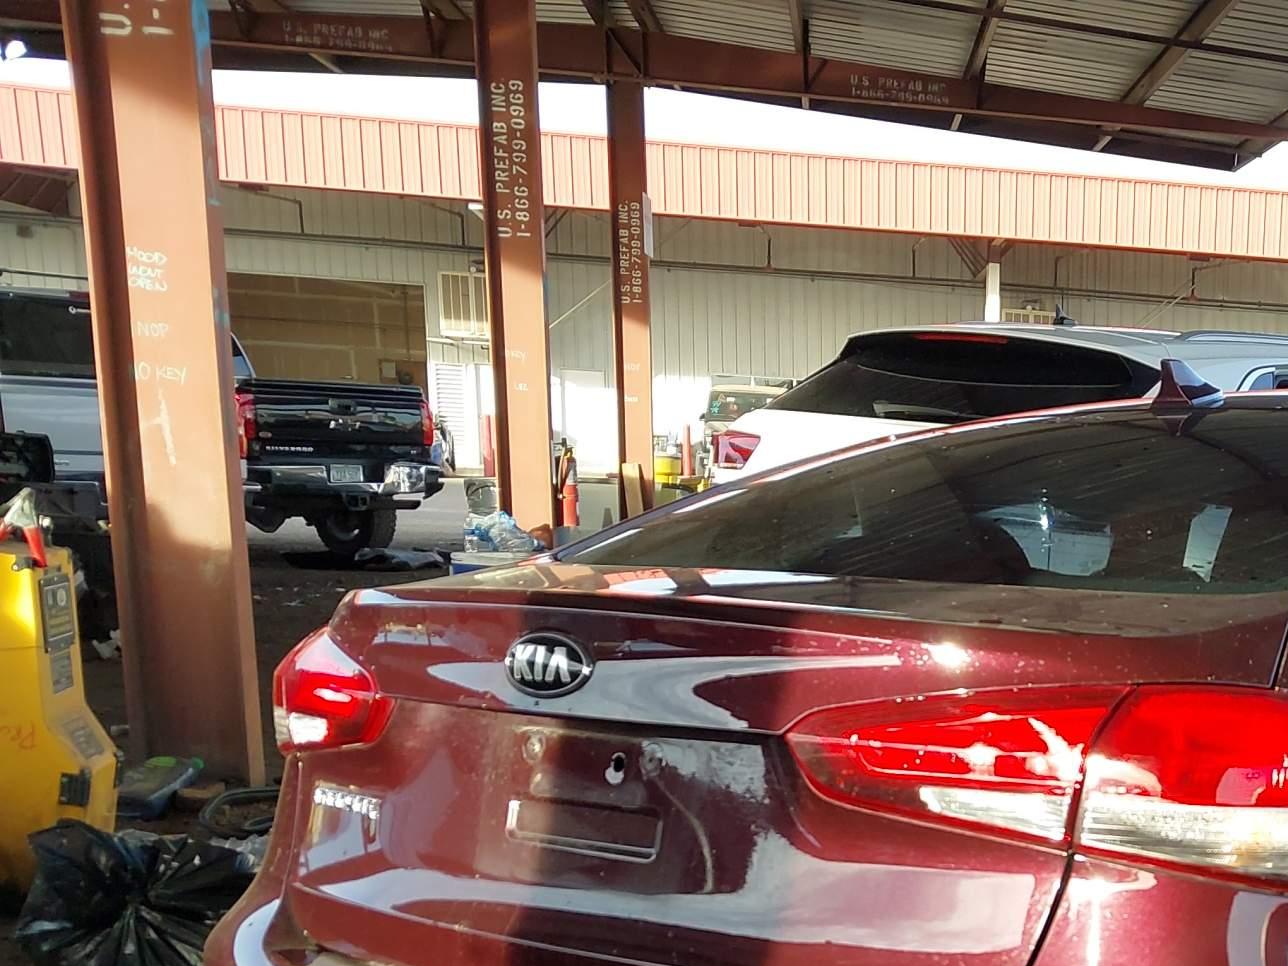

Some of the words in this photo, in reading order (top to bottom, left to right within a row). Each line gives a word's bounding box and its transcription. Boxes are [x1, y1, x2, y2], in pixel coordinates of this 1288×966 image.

[492, 121, 511, 193] PREFAB
[508, 79, 532, 238] 1-866-799-0969
[617, 200, 629, 223] INC.
[618, 228, 632, 275] PREFAB
[629, 201, 643, 303] 1-866-799-0969
[620, 280, 631, 304] U.S.
[155, 365, 187, 385] KEY
[512, 643, 572, 684] KIA
